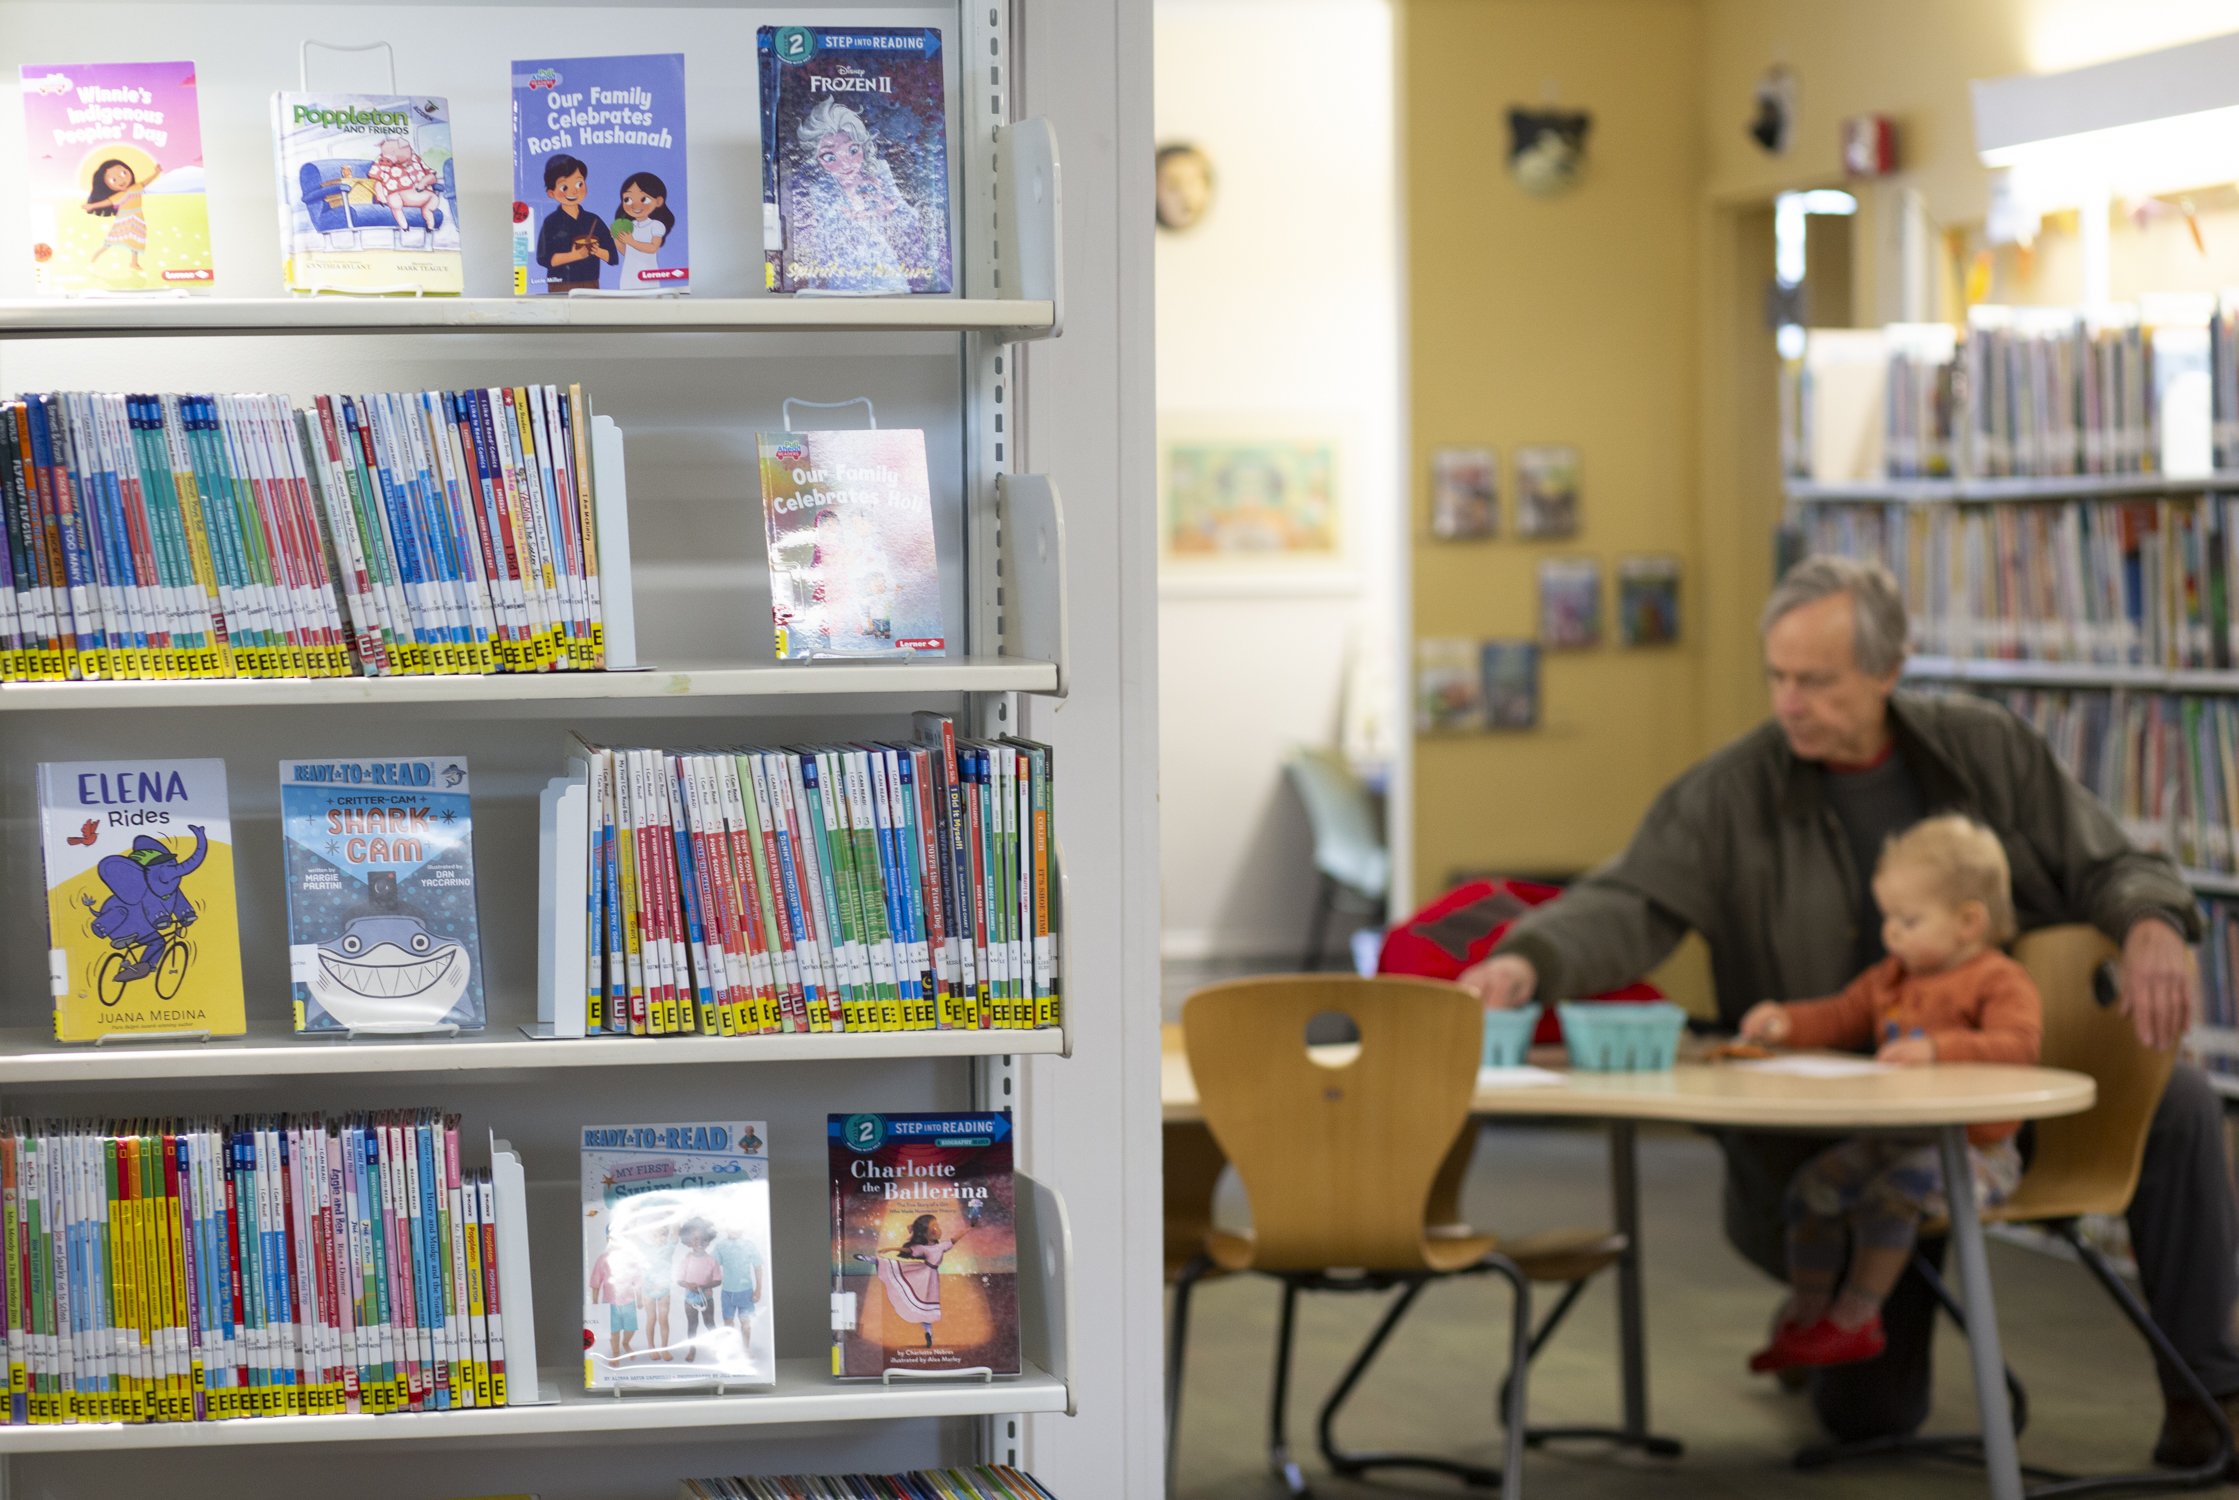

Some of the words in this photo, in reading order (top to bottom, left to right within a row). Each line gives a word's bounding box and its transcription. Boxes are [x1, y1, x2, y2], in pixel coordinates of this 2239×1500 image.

[789, 34, 804, 54] 2
[826, 36, 852, 48] STEP
[854, 37, 872, 46] INTO
[873, 36, 924, 49] READING
[836, 65, 866, 78] Disney
[810, 76, 876, 93] FROZEN
[878, 77, 892, 94] II
[76, 86, 152, 104] Winnie's
[548, 92, 583, 110] Our
[590, 86, 652, 110] Family
[66, 104, 164, 124] Indigenous
[293, 104, 409, 128] Poppleton
[548, 106, 653, 130] Celebrates
[52, 122, 127, 146] Peoples'
[132, 123, 168, 148] Day
[344, 126, 365, 134] AND
[368, 126, 410, 134] FRIENDS
[526, 129, 572, 155] Rosh
[579, 125, 672, 149] Hashanah
[642, 270, 670, 279] Lerner
[470, 405, 478, 417] Like
[481, 405, 490, 417] Like
[6, 411, 18, 442] ARNOLD
[474, 427, 482, 444] Read
[485, 427, 494, 444] Read
[477, 447, 487, 468] Comics
[488, 447, 498, 468] Comics
[12, 460, 23, 475] FLY
[792, 468, 828, 485] Our
[835, 463, 899, 488] Family
[14, 478, 26, 495] GUY
[496, 489, 505, 516] EMBERLEY
[519, 490, 532, 522] YASMIN
[582, 500, 589, 509] Am
[773, 487, 878, 514] Celebrates
[18, 505, 28, 521] FLY
[20, 523, 32, 546] GIRL
[525, 526, 534, 536] The
[583, 512, 592, 541] McKinley
[66, 528, 76, 549] TOO
[528, 542, 539, 566] Soccer
[69, 552, 81, 581] MANY
[16, 656, 24, 672] E
[29, 656, 38, 672] E
[126, 655, 136, 671] E
[945, 735, 953, 760] Montessori
[294, 764, 336, 782] READY
[340, 764, 362, 784] TO
[371, 762, 431, 787] READ
[78, 770, 188, 804] ELENA
[337, 795, 416, 806] CRITTER-CAM
[950, 794, 960, 809] Did
[108, 809, 170, 827] Rides
[327, 807, 438, 835] SHARK-
[952, 820, 963, 849] Myself!
[1037, 817, 1045, 851] COLLIER
[346, 838, 424, 864] CAM
[767, 838, 777, 863] BREAD
[305, 874, 339, 882] MARGIE
[436, 870, 455, 879] DAN
[770, 864, 779, 878] AND
[303, 882, 342, 890] PALATINI
[421, 878, 471, 887] YACCARINO
[772, 880, 781, 894] JAM
[775, 896, 784, 907] FOR
[930, 888, 940, 912] Pirate
[1038, 887, 1046, 910] SHOE
[776, 909, 790, 942] FRANCES
[932, 915, 942, 929] Dog
[97, 1012, 144, 1024] JUANA
[150, 1010, 206, 1020] MEDINA
[591, 1002, 600, 1018] E
[652, 1011, 661, 1026] E
[668, 1008, 676, 1024] E
[967, 1008, 976, 1022] E
[1024, 1005, 1032, 1020] E
[1041, 1005, 1048, 1020] E
[859, 1122, 874, 1142] 2
[895, 1123, 922, 1134] STEP
[924, 1124, 942, 1132] INTO
[942, 1122, 994, 1134] READING
[584, 1129, 627, 1148] READY
[633, 1128, 656, 1148] TO
[666, 1126, 728, 1150] READ
[616, 1168, 634, 1178] MY
[636, 1164, 670, 1176] FIRST
[850, 1159, 956, 1178] Charlotte
[330, 1169, 341, 1194] Aggie
[862, 1182, 880, 1192] the
[884, 1182, 989, 1200] Ballerina
[333, 1198, 343, 1215] and
[426, 1192, 436, 1216] Henry
[323, 1210, 332, 1237] Makeda
[335, 1218, 344, 1235] Ben
[6, 1228, 16, 1252] Moody
[55, 1231, 66, 1242] Joe
[468, 1227, 477, 1263] Poppleton
[485, 1227, 494, 1263] Poppleton
[9, 1253, 16, 1261] in
[56, 1245, 64, 1254] and
[297, 1240, 306, 1259] Going
[325, 1239, 334, 1261] Makes
[428, 1236, 438, 1262] Mudge
[9, 1264, 17, 1275] The
[55, 1256, 66, 1279] Sparky
[300, 1260, 305, 1268] on
[300, 1276, 308, 1292] Field
[338, 1267, 348, 1295] Dormer
[471, 1269, 479, 1302] POPPLETON
[8, 1278, 18, 1308] Birthday
[300, 1293, 308, 1305] Trip
[59, 1302, 69, 1323] School
[432, 1296, 442, 1323] Sneaky
[462, 1366, 472, 1382] E
[478, 1382, 488, 1397] E
[495, 1380, 504, 1396] E
